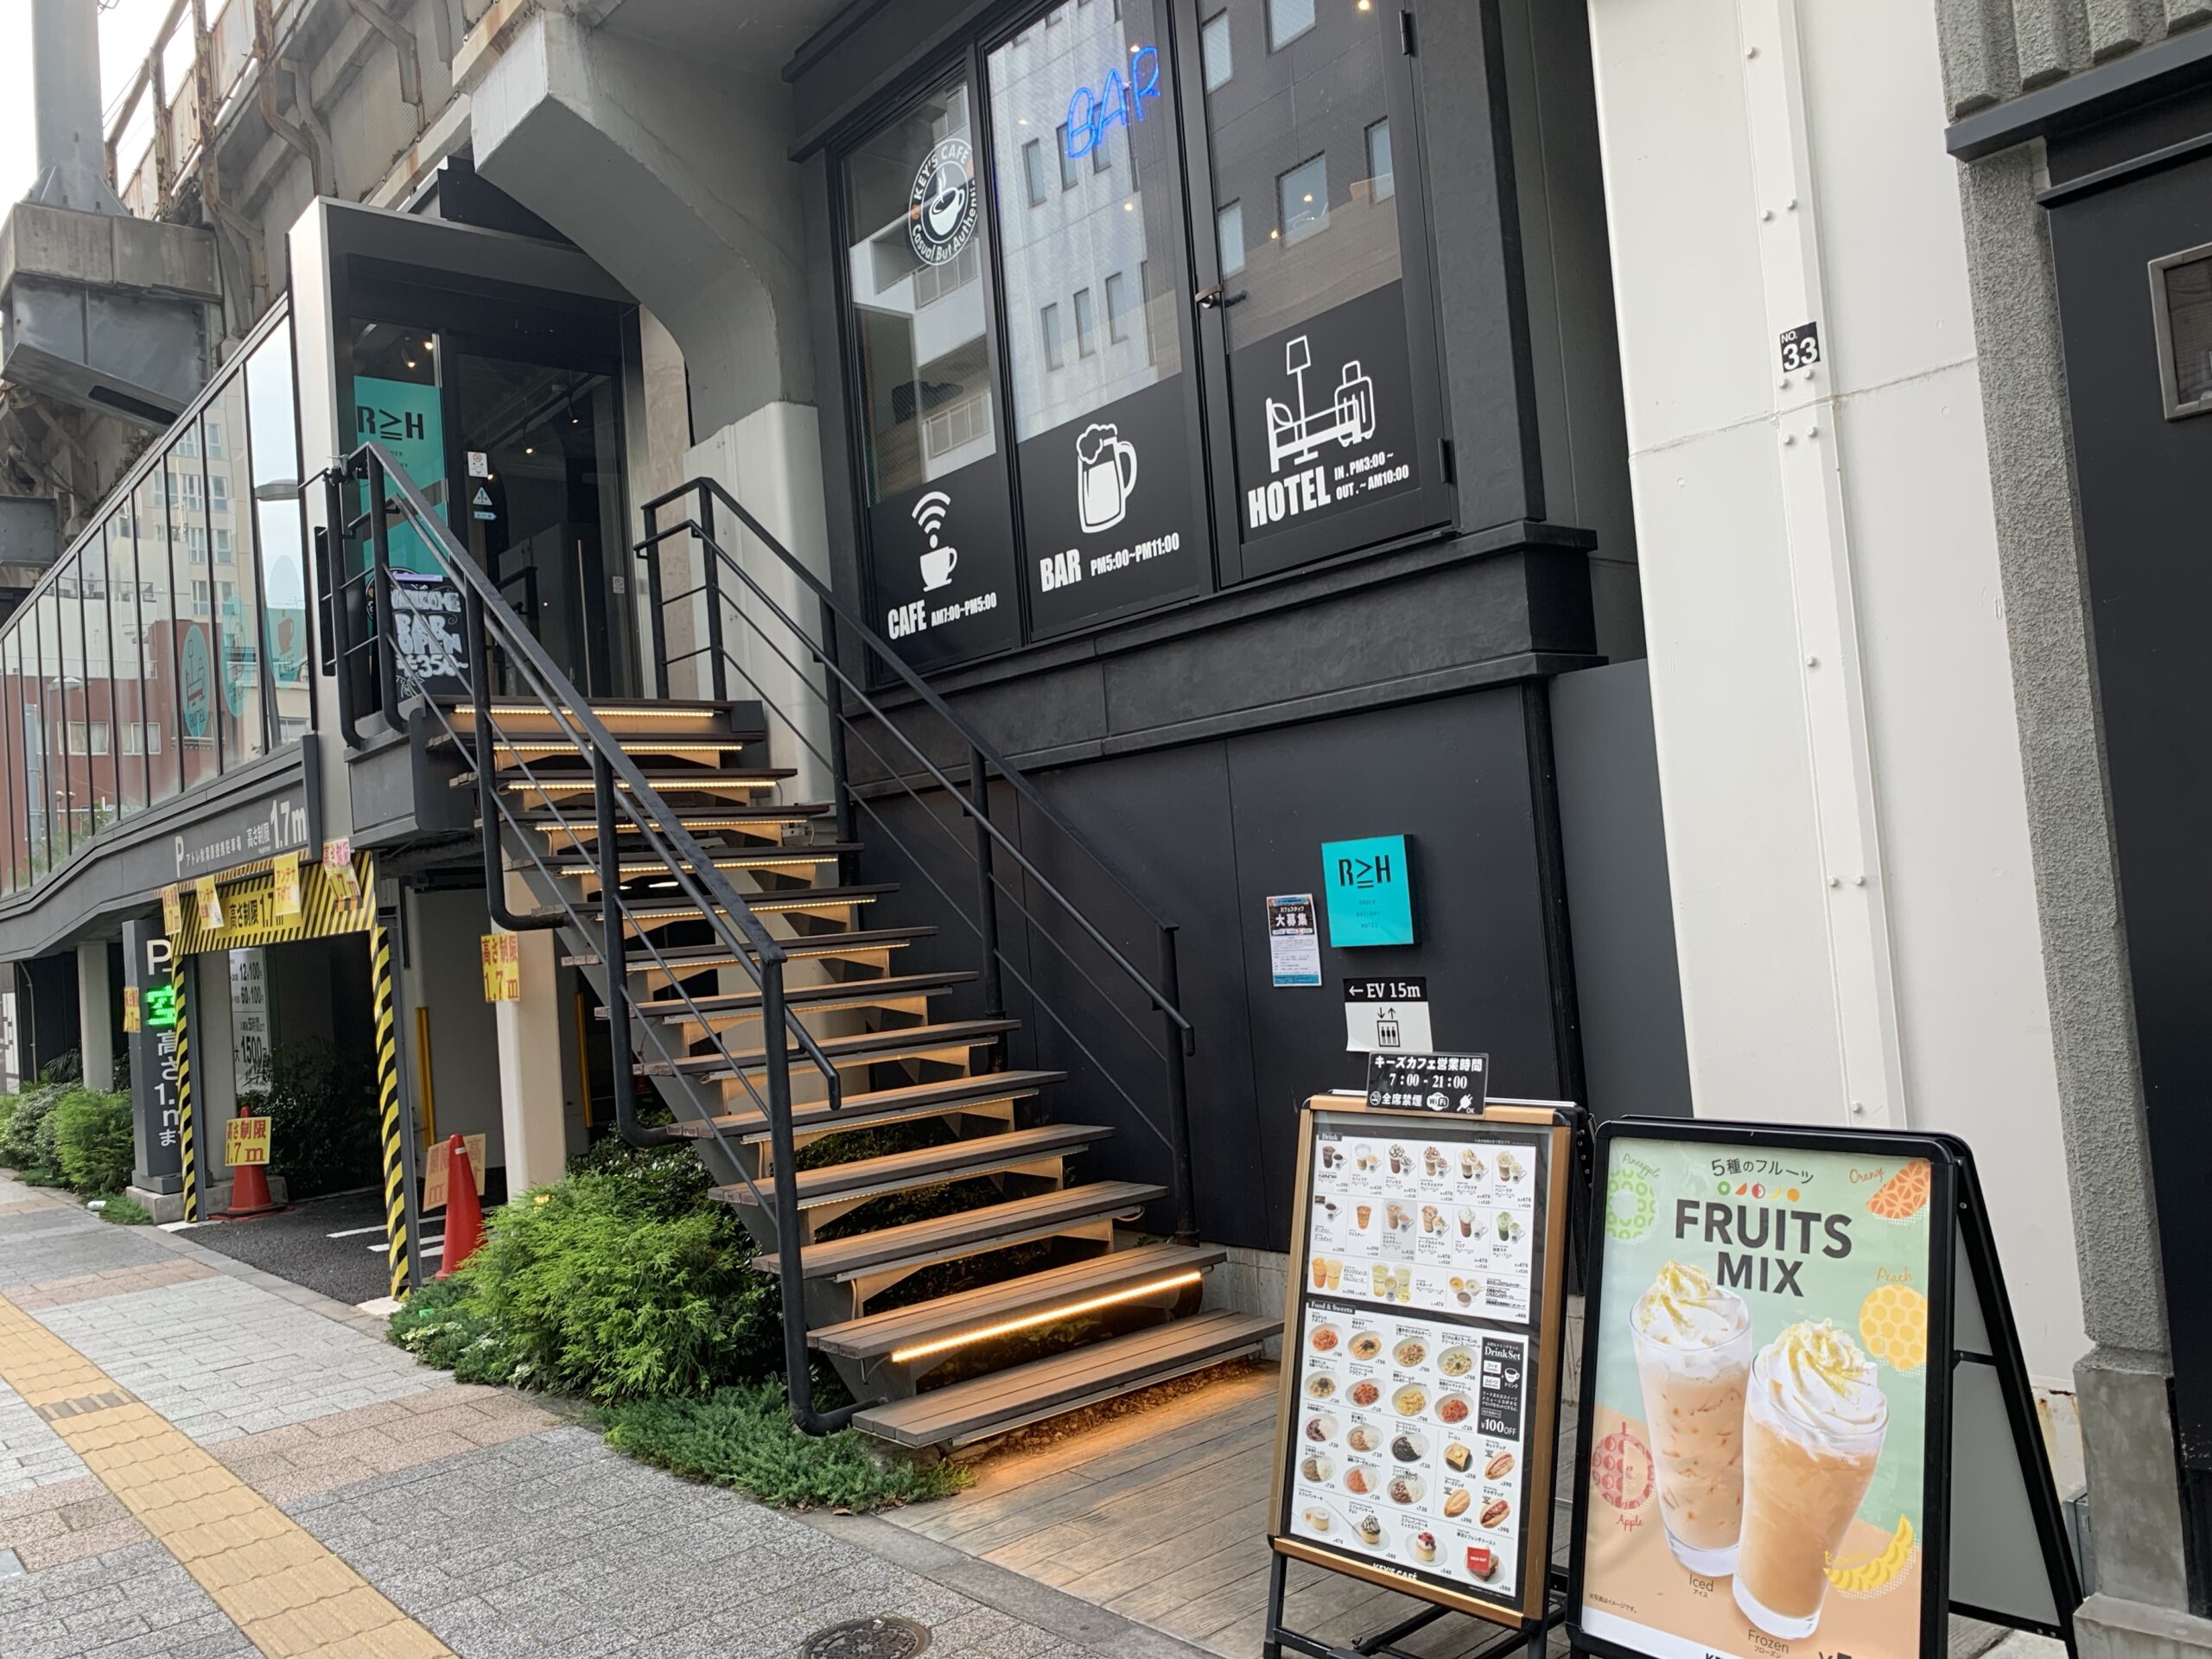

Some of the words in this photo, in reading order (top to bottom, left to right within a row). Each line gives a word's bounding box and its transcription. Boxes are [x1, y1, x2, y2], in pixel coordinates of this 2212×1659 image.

[1065, 45, 1160, 159] BAR
[913, 154, 938, 200] KEY'S
[912, 224, 936, 261] Casual
[936, 245, 952, 262] But
[1781, 330, 1798, 344] NO.
[1783, 336, 1818, 371] 33
[1248, 466, 1332, 529] HOTEL
[1039, 548, 1082, 593] BAR
[887, 599, 927, 640] CAFE
[175, 836, 184, 878] P
[270, 799, 308, 849] 1.7m
[229, 899, 258, 930] 高さ制限
[1275, 913, 1308, 927] 大募集
[1366, 982, 1384, 998] EV
[1390, 982, 1421, 998] 15m
[1375, 1056, 1483, 1072] キーズカフェ営業時間
[1382, 1092, 1422, 1107] 全席禁煙
[227, 1119, 266, 1141] 高さ制限
[226, 1141, 264, 1165] 1.7m
[1623, 1153, 1661, 1180] Pineapple
[1712, 1158, 1815, 1184] 5種のフルーツ
[1849, 1166, 1885, 1184] Orange
[1675, 1198, 1853, 1259] FRUITS
[1717, 1251, 1804, 1297] MIX
[1876, 1265, 1913, 1282] Peach
[1311, 1301, 1325, 1310] Food
[1332, 1304, 1353, 1313] Sweets
[1616, 1514, 1644, 1532] Apple
[1689, 1573, 1714, 1592] Iced
[1694, 1588, 1708, 1598] アイス
[1748, 1629, 1789, 1654] Frozen
[1754, 1646, 1782, 1658] フローズン
